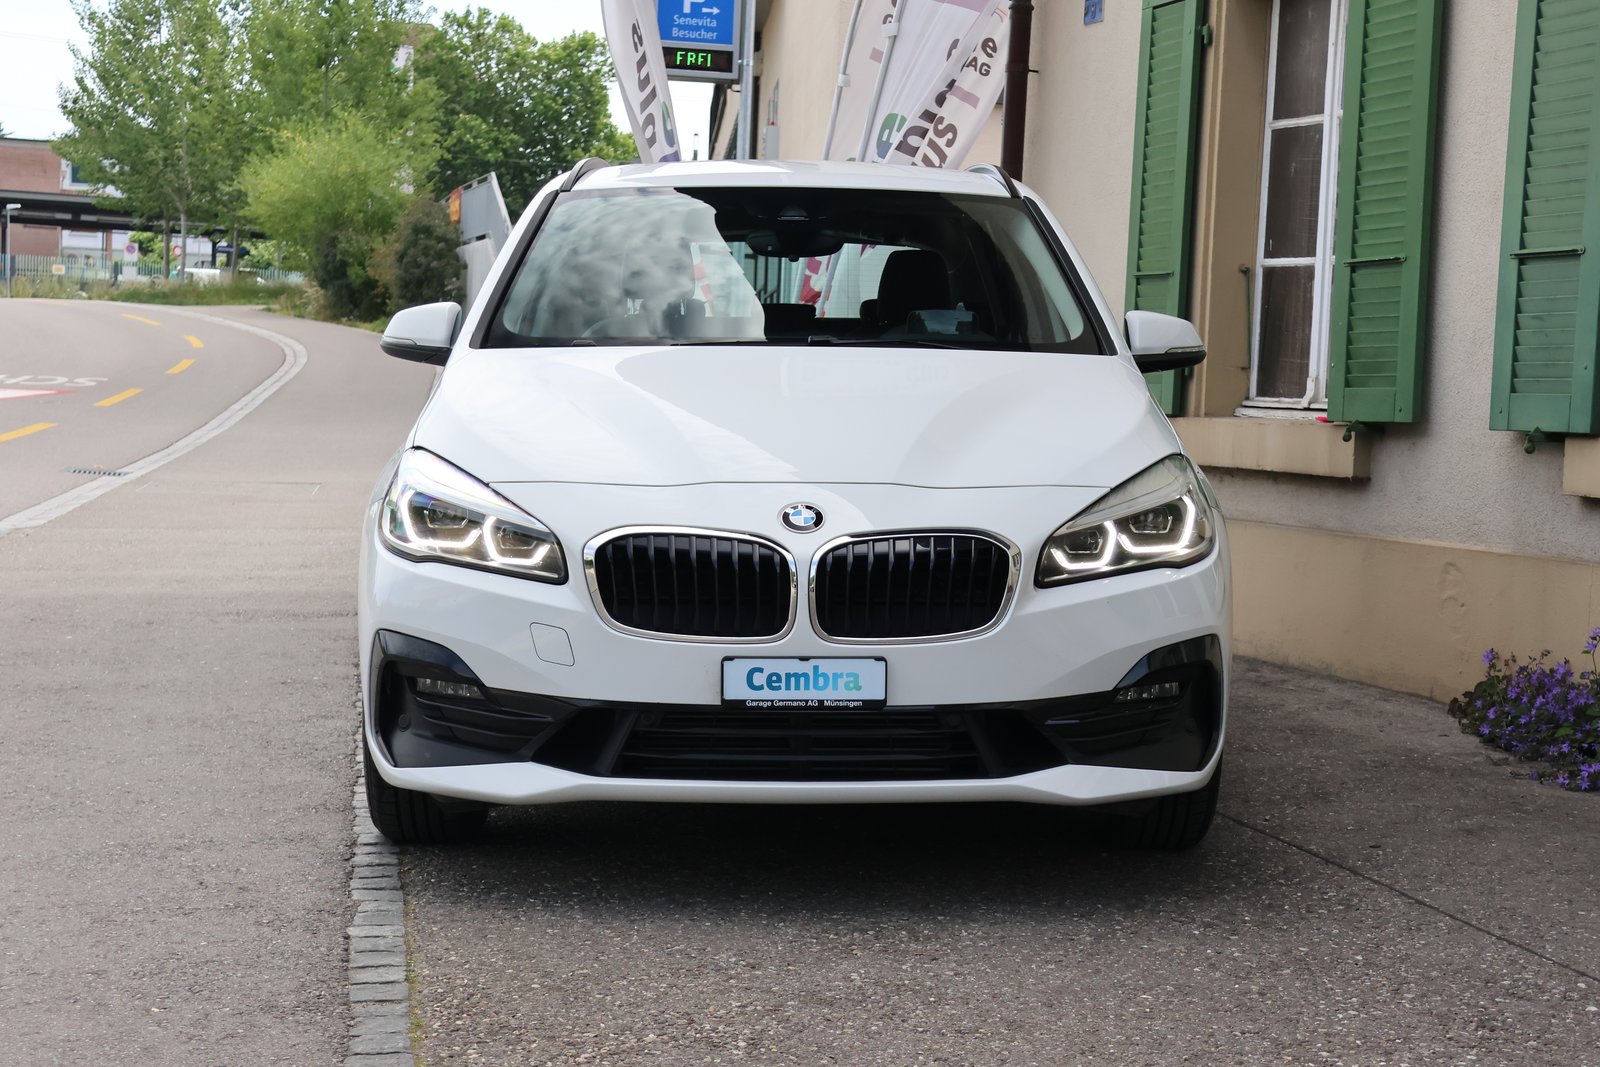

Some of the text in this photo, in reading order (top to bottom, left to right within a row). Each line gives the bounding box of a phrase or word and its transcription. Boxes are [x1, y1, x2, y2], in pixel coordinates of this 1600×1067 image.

[673, 14, 717, 27] Senevita
[672, 27, 718, 40] Besucher
[746, 665, 862, 692] Cembra
[746, 700, 771, 708] Garage
[824, 699, 862, 707] Münsingen
